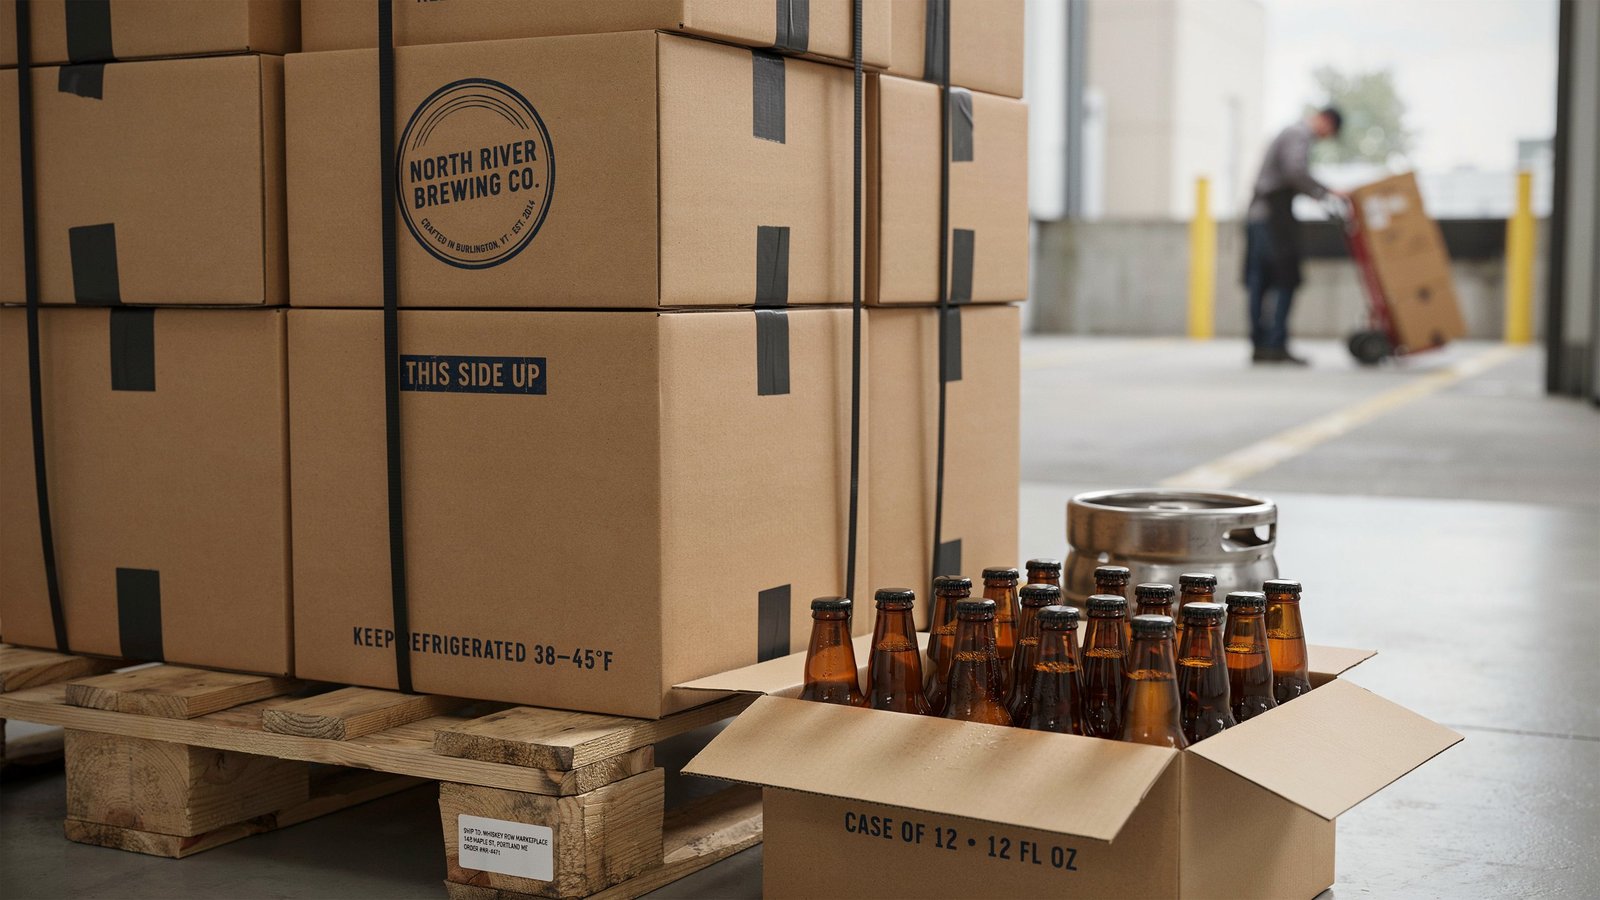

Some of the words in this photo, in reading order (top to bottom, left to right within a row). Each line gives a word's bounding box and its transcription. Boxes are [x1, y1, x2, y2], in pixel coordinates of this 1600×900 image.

[410, 150, 472, 183] NORTH
[480, 139, 537, 171] RIVER
[414, 173, 500, 210] BREWING
[508, 167, 540, 193] CO.
[421, 218, 446, 244] CRAFTED
[448, 240, 454, 248] IN
[456, 241, 500, 253] BURLINGTON,
[500, 234, 510, 245] VT
[512, 220, 526, 234] EST.
[522, 199, 536, 220] 2014
[406, 362, 450, 386] THIS
[458, 362, 504, 386] SIDE
[512, 364, 540, 388] UP
[353, 626, 394, 648] KEEP
[473, 838, 488, 846] MAPLE
[497, 841, 520, 850] PORTLAND
[483, 830, 504, 840] WHISKEY
[504, 833, 516, 841] ROW
[516, 834, 548, 846] MARKETPLACE
[845, 812, 893, 840] CASE
[902, 820, 925, 844] OF
[935, 827, 958, 850] 12
[988, 836, 1010, 860] 12
[1020, 841, 1042, 865] FL
[1050, 846, 1078, 871] OZ
